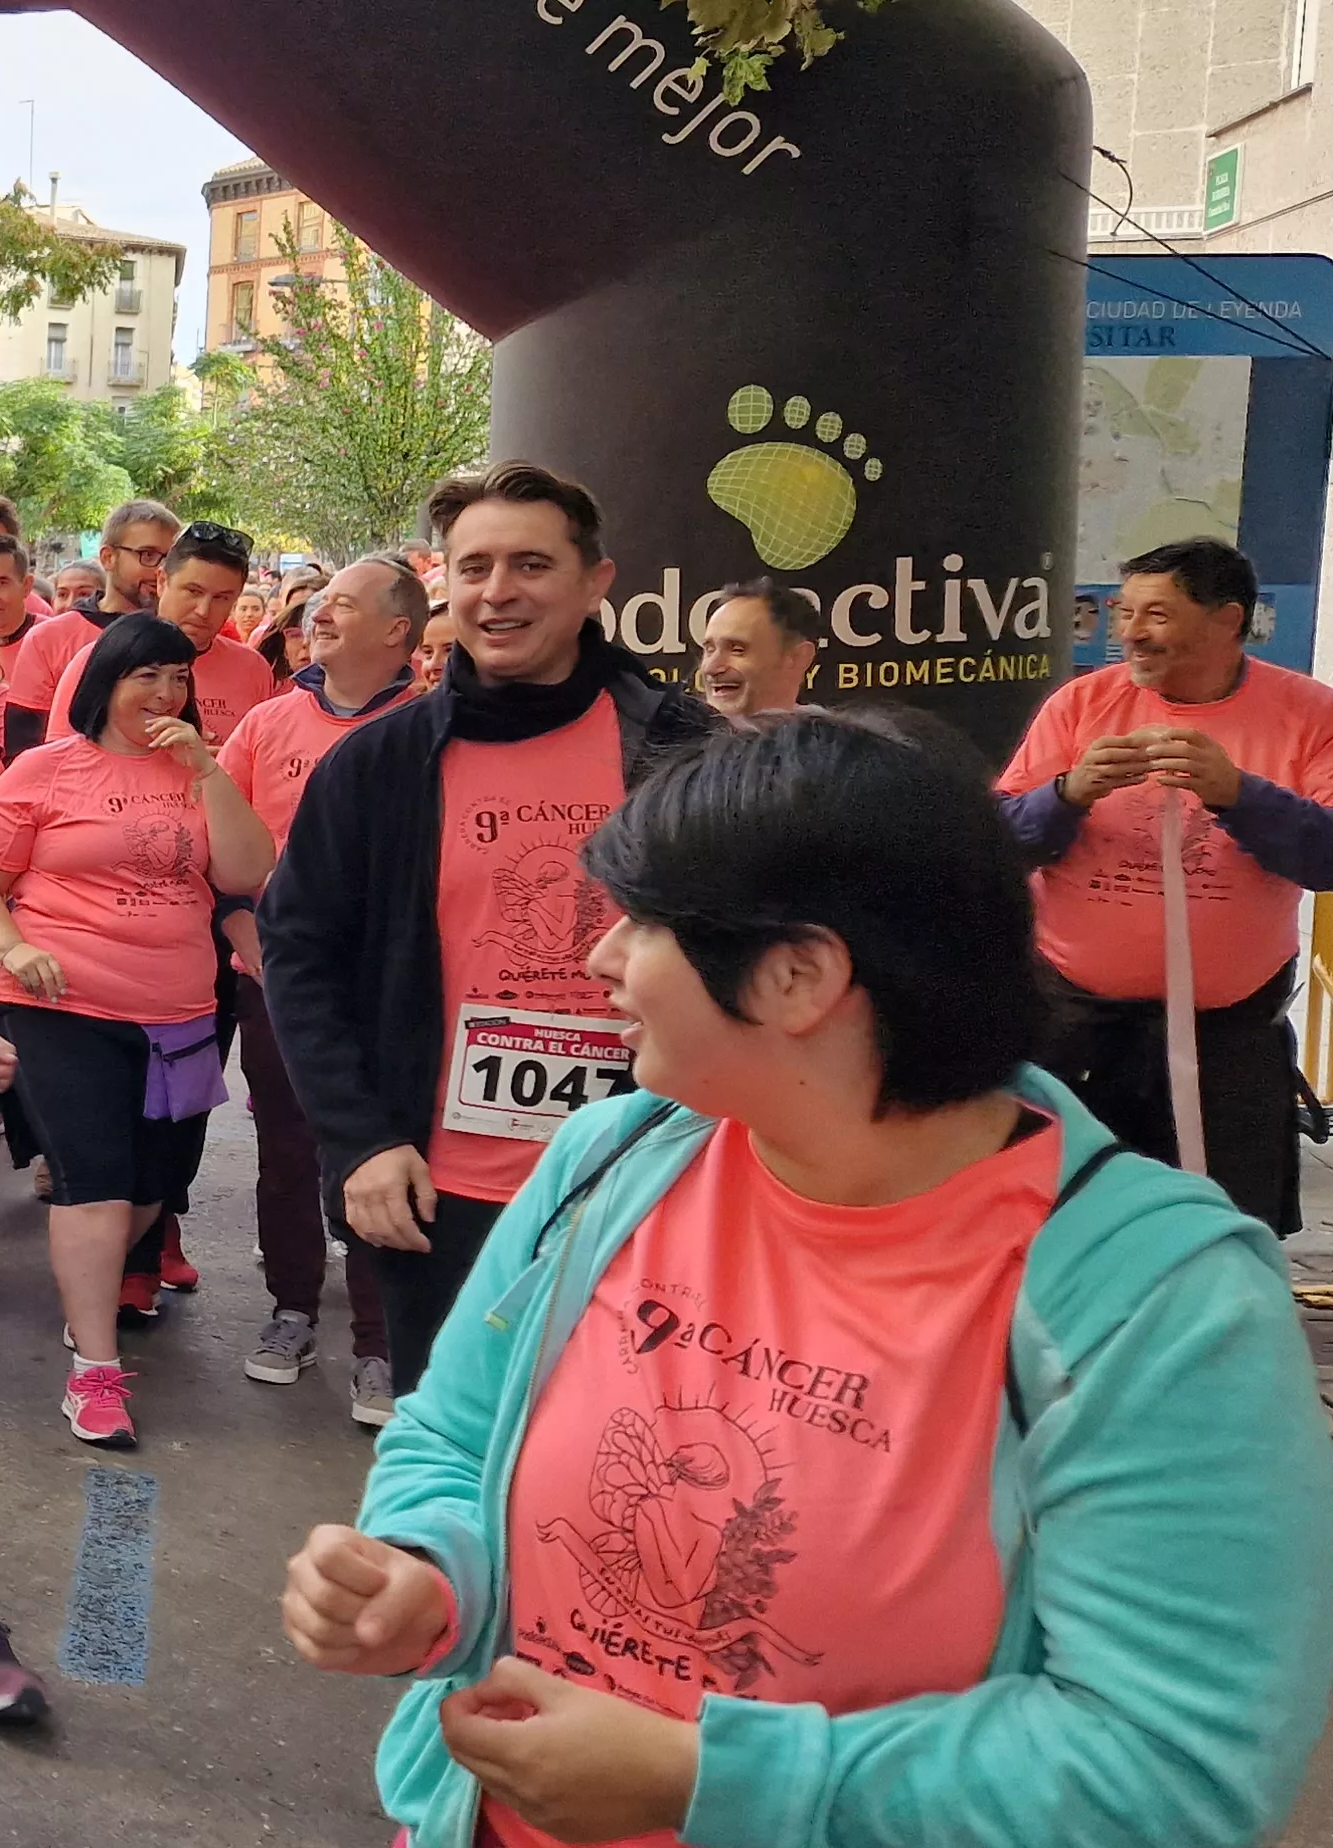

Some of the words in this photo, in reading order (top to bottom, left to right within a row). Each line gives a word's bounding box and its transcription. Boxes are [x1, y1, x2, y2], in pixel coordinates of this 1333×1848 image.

[585, 14, 801, 175] mejor
[1086, 301, 1165, 319] CIUDAD
[1173, 301, 1198, 318] DE
[1087, 325, 1176, 348] SITAR
[837, 649, 1051, 690] BIOMECÁNICA
[516, 800, 611, 823] CÁNCER
[476, 1032, 545, 1052] CONTRA
[548, 1041, 566, 1055] EL
[570, 1042, 630, 1060] CÁNCER
[534, 1028, 581, 1042] HUESCA
[472, 1055, 631, 1112] 1047
[699, 1322, 871, 1412] CÁNCER
[768, 1388, 891, 1452] HUESCA
